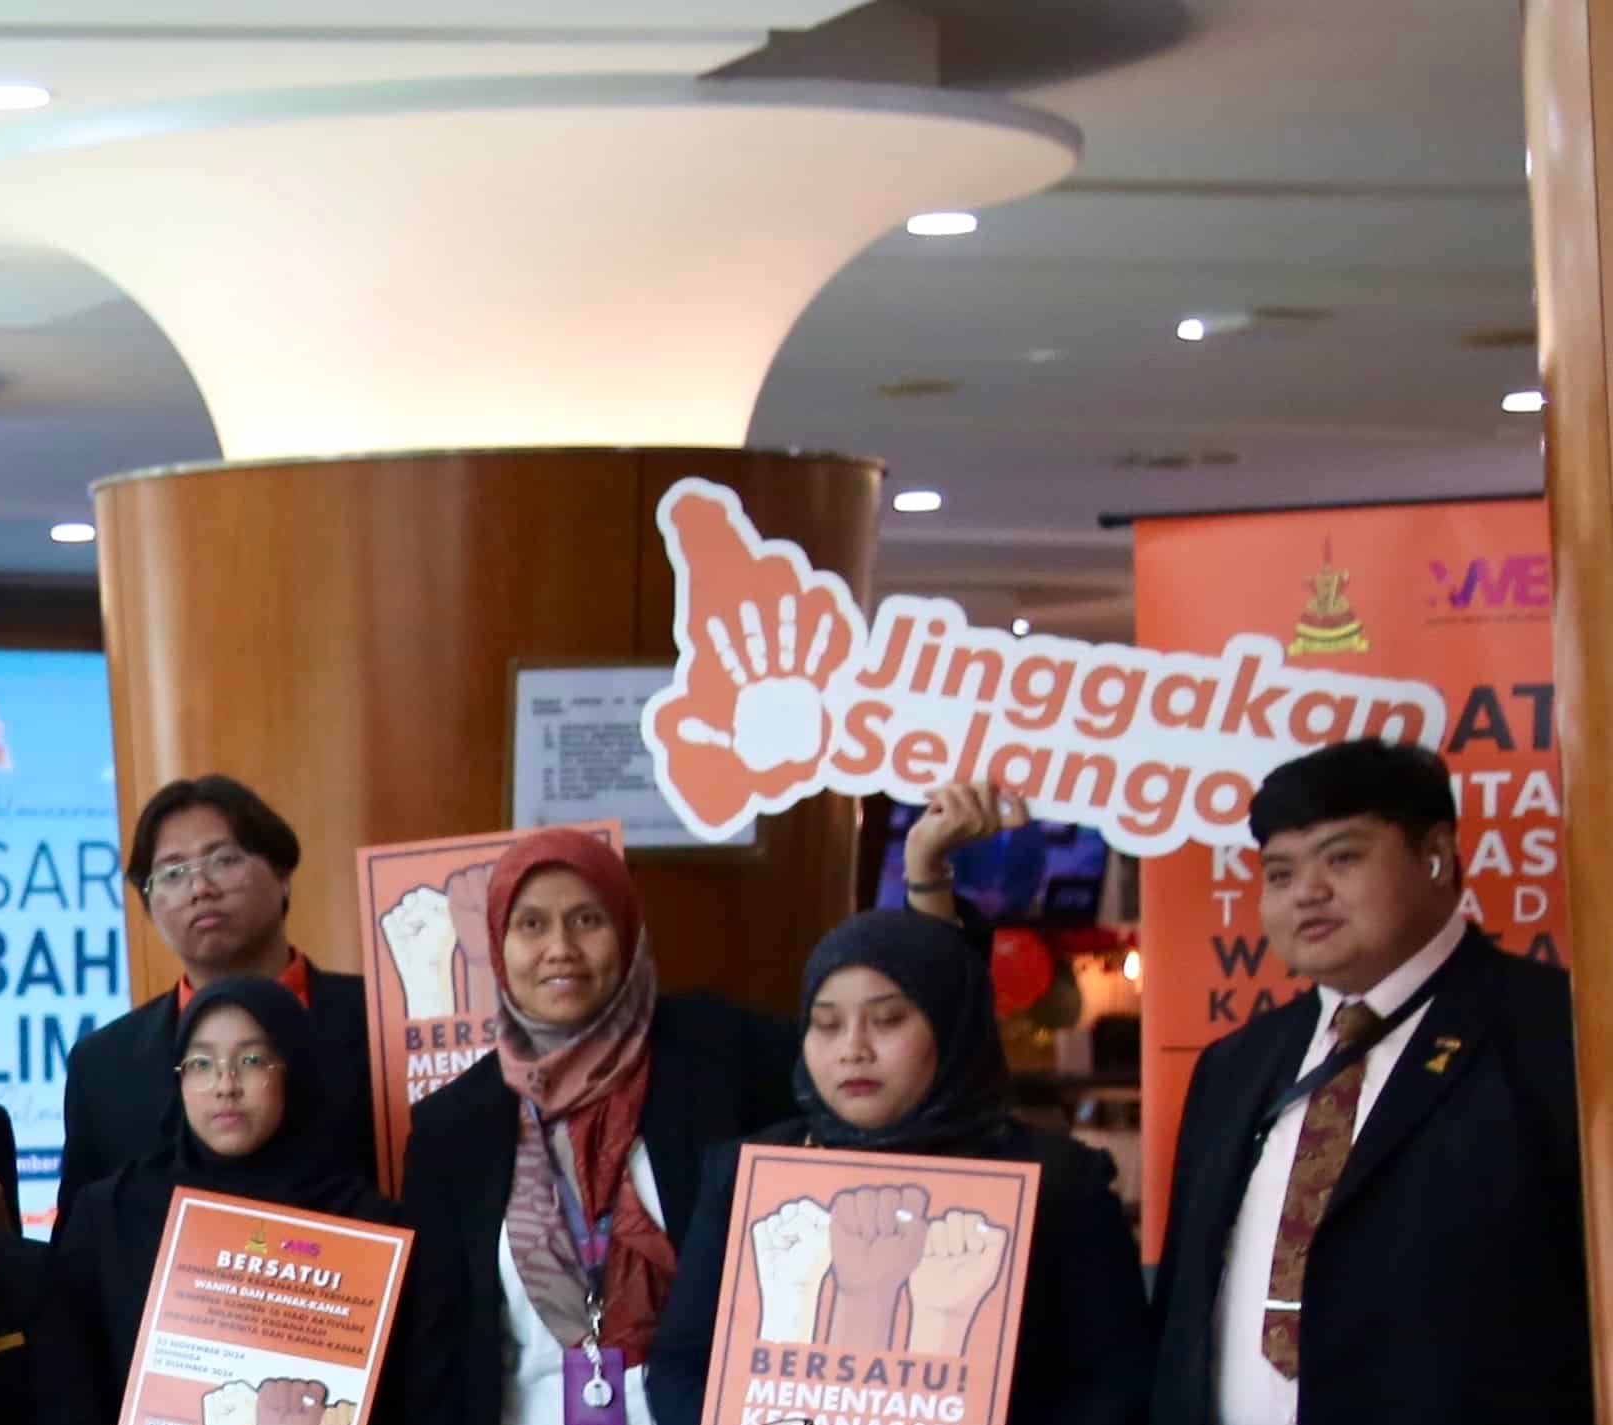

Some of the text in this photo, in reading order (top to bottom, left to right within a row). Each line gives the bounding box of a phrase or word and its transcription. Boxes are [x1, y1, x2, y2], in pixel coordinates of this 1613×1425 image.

[856, 614, 1427, 748] Jinggakan
[828, 698, 1254, 838] Selango
[405, 1018, 497, 1050] BERS
[194, 1279, 238, 1297] WANITA
[216, 1250, 342, 1290] BERSATU!
[750, 1347, 968, 1393] BERSATU!
[744, 1378, 966, 1424] MENENTANG
